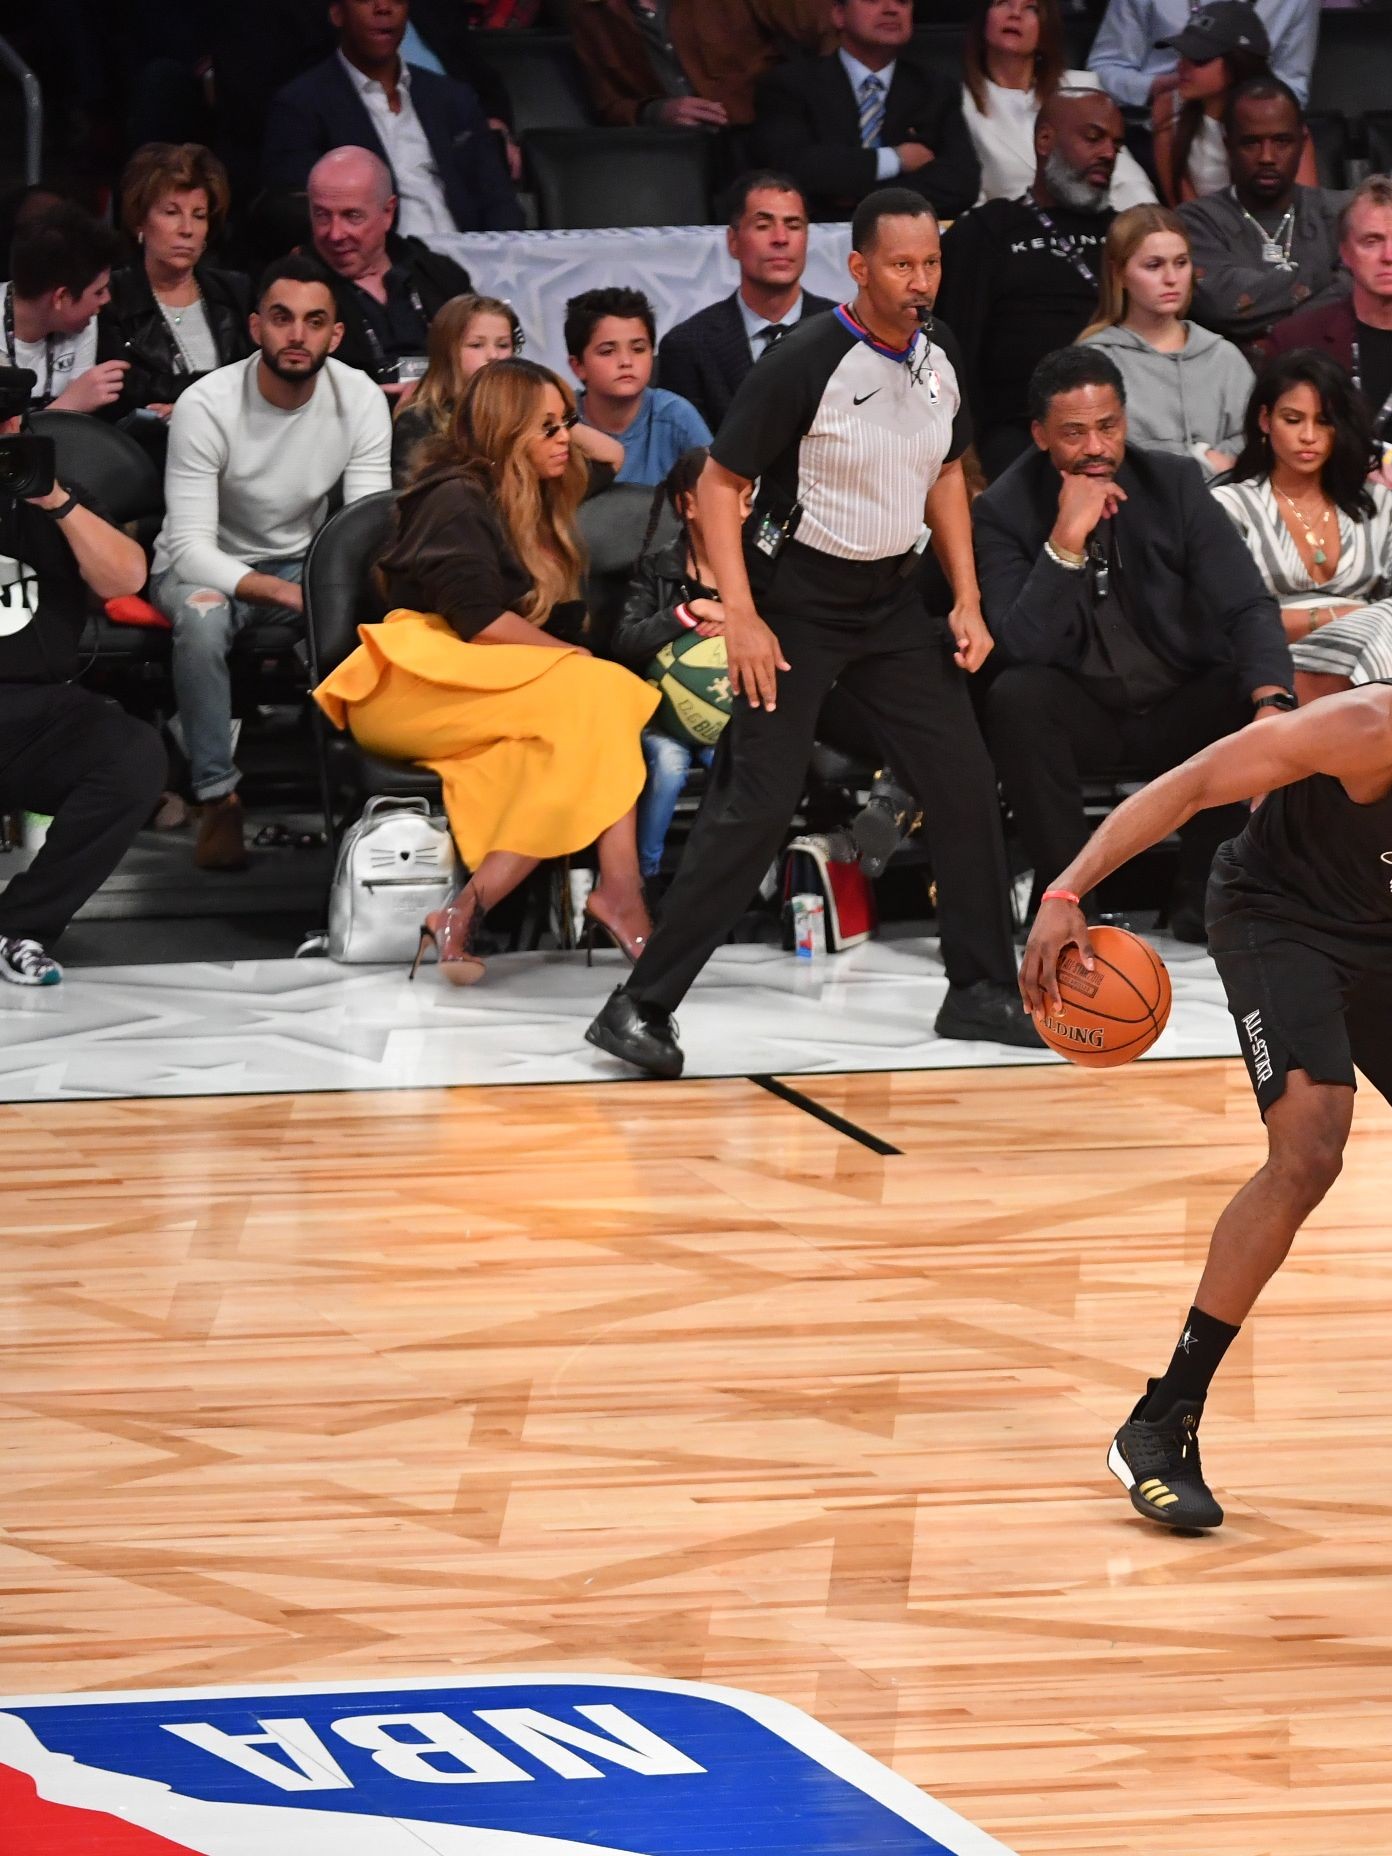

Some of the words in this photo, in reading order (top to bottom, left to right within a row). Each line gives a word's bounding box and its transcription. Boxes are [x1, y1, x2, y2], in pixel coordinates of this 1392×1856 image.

[1040, 1016, 1105, 1049] ALDING
[1240, 1008, 1274, 1091] ALL-STAR
[157, 1702, 710, 1793] NBA
